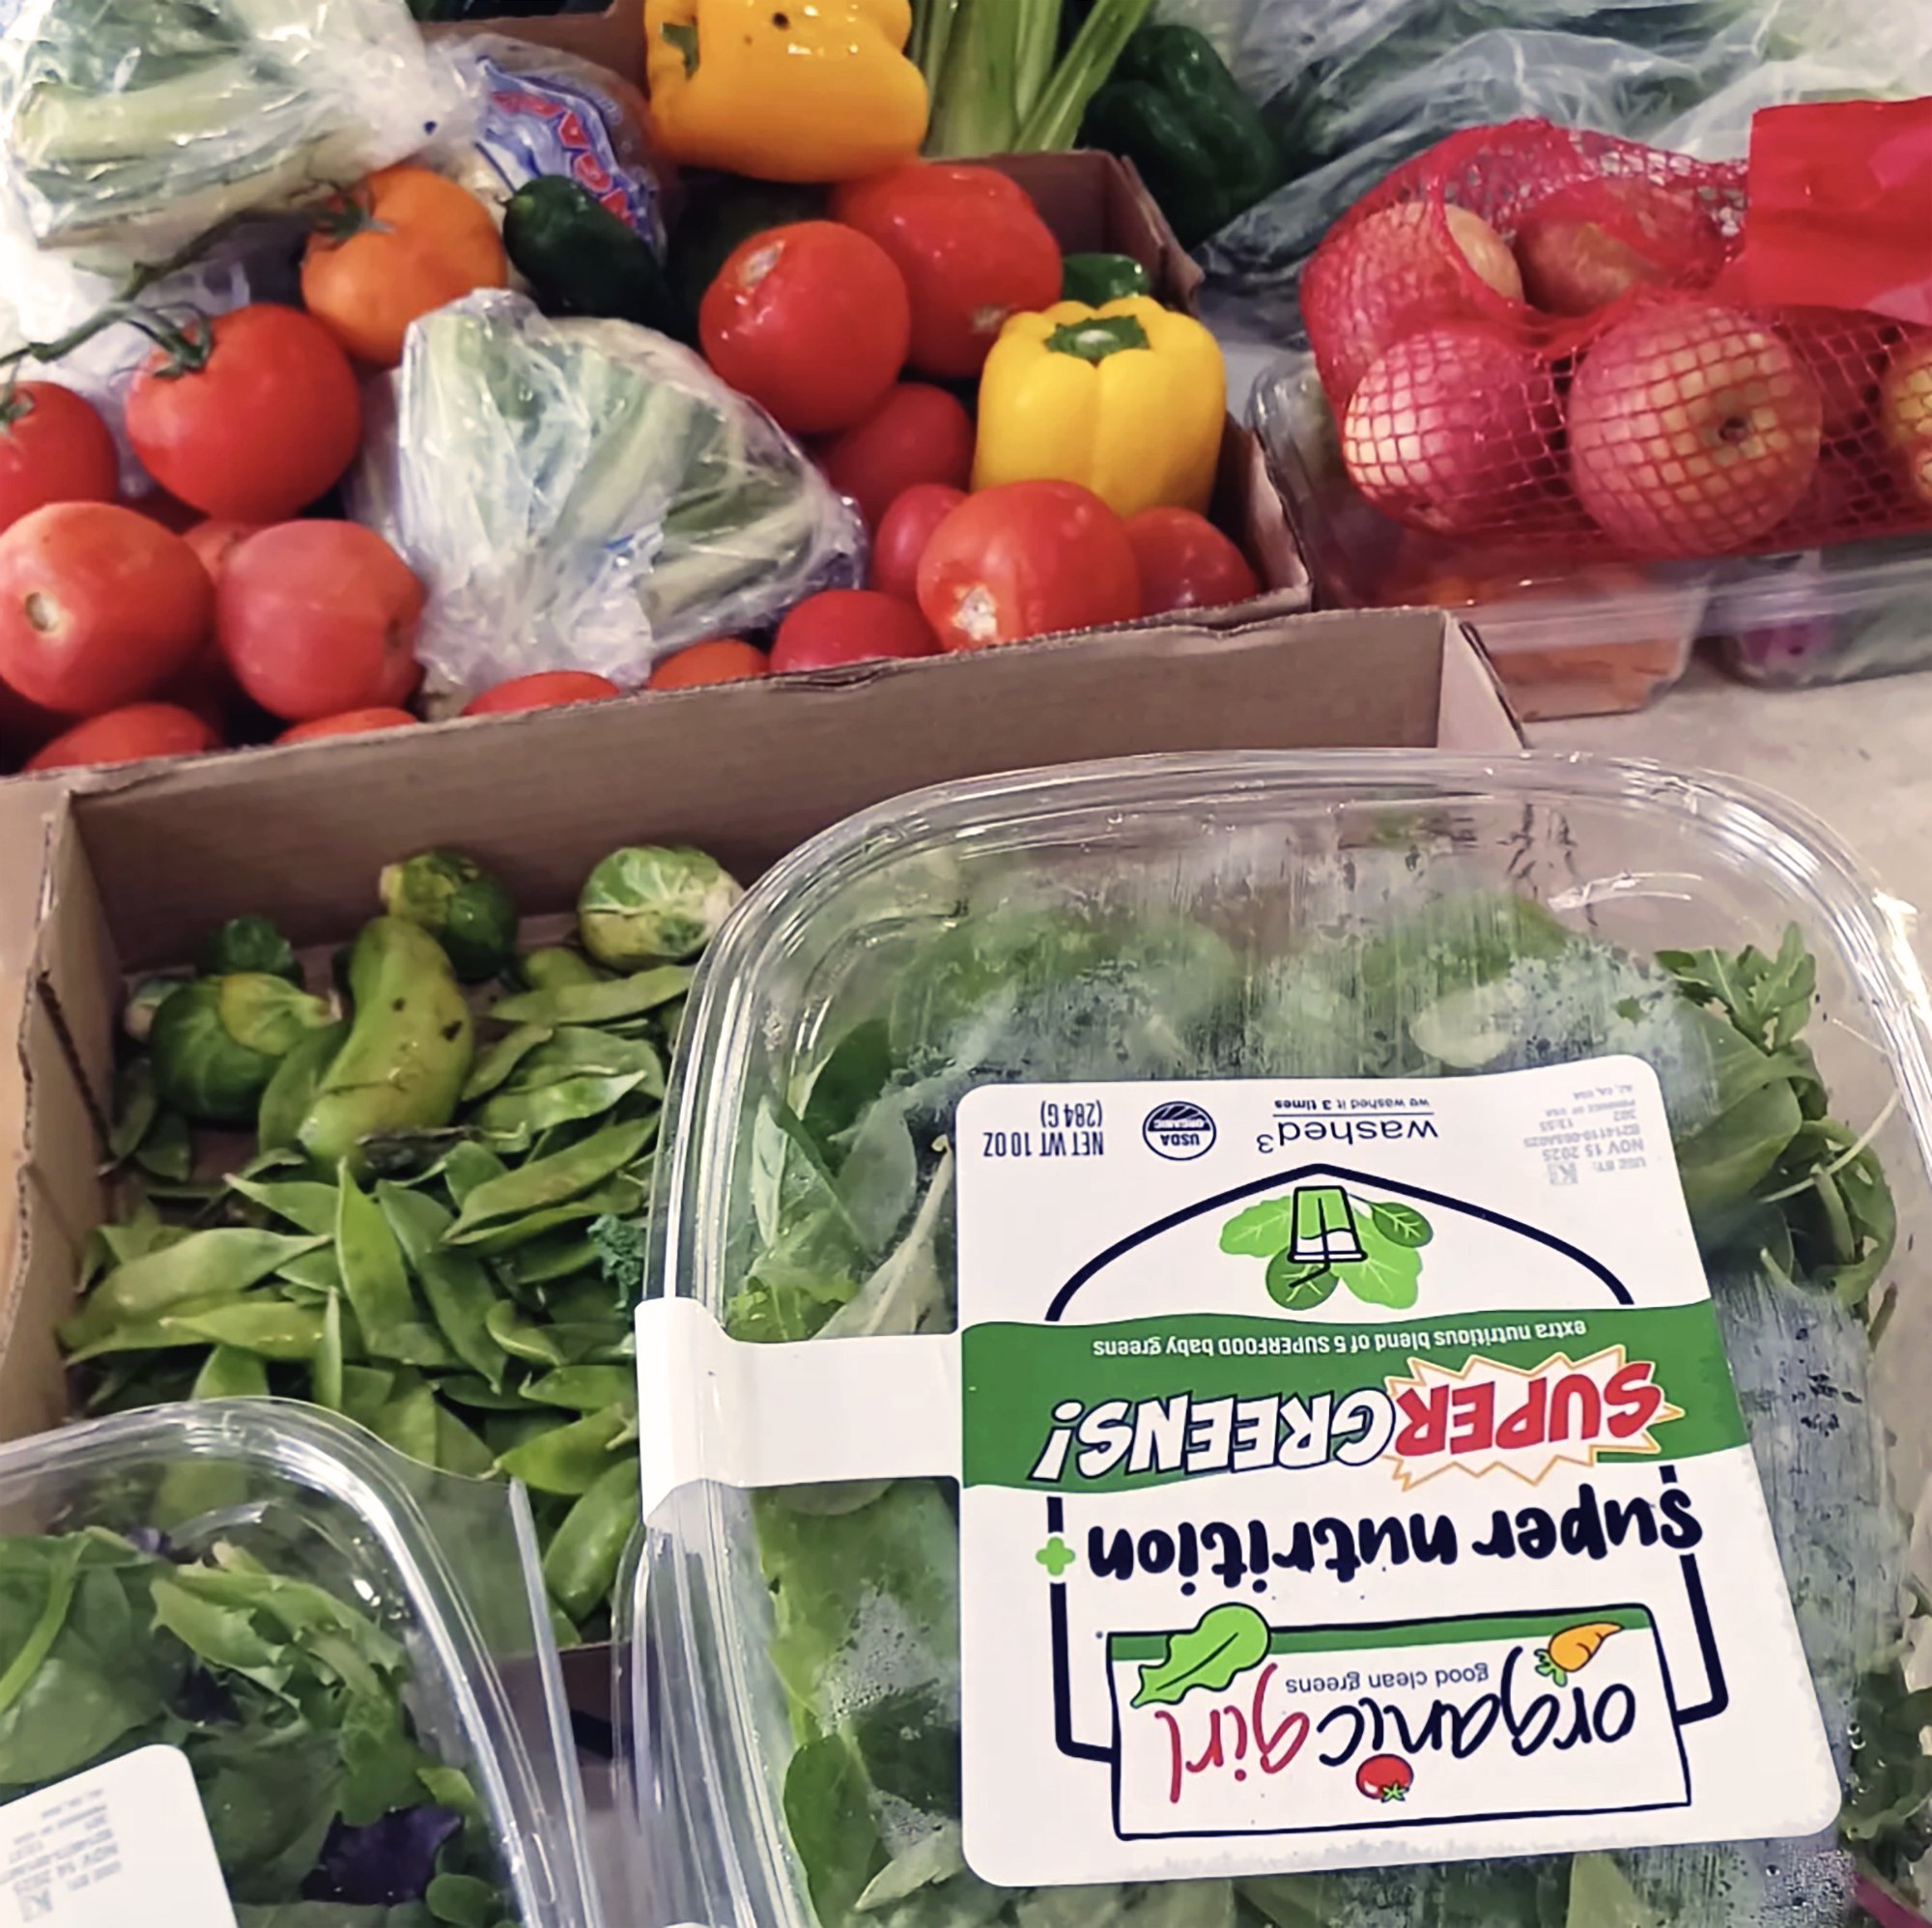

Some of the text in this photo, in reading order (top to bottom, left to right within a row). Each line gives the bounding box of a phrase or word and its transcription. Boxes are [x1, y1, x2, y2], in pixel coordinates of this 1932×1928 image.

[1064, 1099, 1102, 1128] (284
[1274, 1098, 1430, 1111] we washed it 3 times
[982, 1130, 1104, 1157] NET WT 10 OZ
[1160, 1134, 1200, 1147] USDA
[1093, 1320, 1587, 1356] extra nutritious blend of 5 SUPERFOOD baby greens
[1088, 1484, 1702, 1596] super nutrition
[1286, 1662, 1489, 1693] good clean greens
